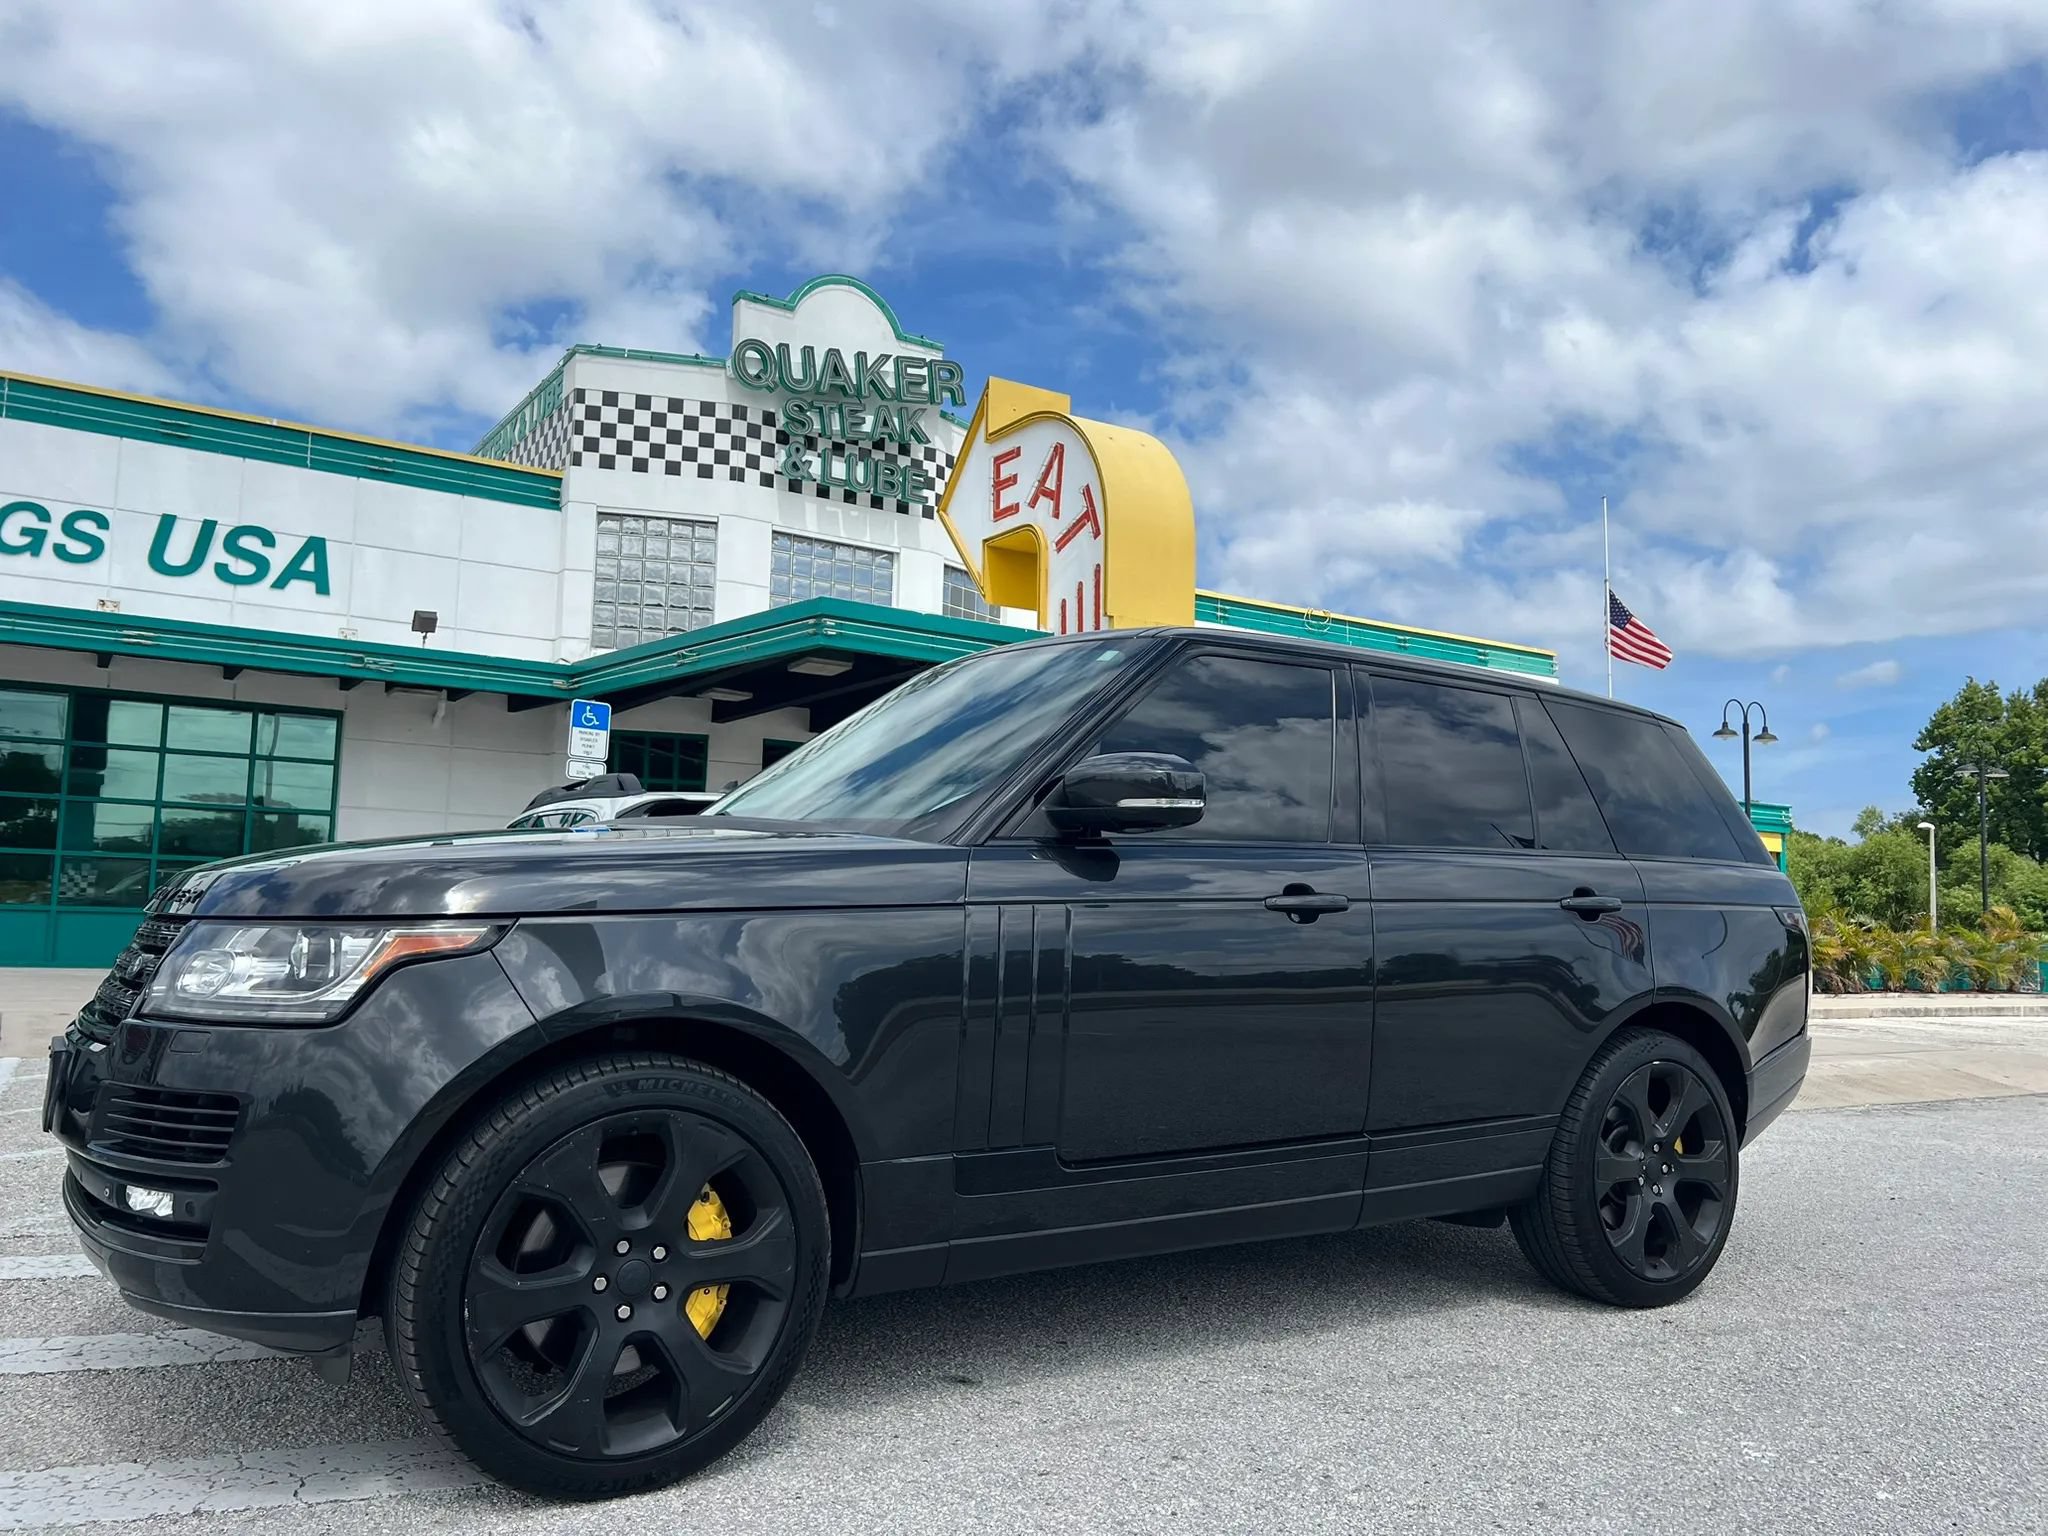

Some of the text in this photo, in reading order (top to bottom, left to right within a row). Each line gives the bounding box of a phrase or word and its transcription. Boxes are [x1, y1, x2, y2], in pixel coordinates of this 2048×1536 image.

[528, 373, 564, 431] LUBE
[732, 338, 967, 407] QUAKER
[782, 397, 932, 445] STEAK
[781, 440, 930, 504] & LUBE
[991, 442, 1101, 554] EAT
[147, 513, 331, 596] USA
[637, 1078, 745, 1107] MICHELIN
